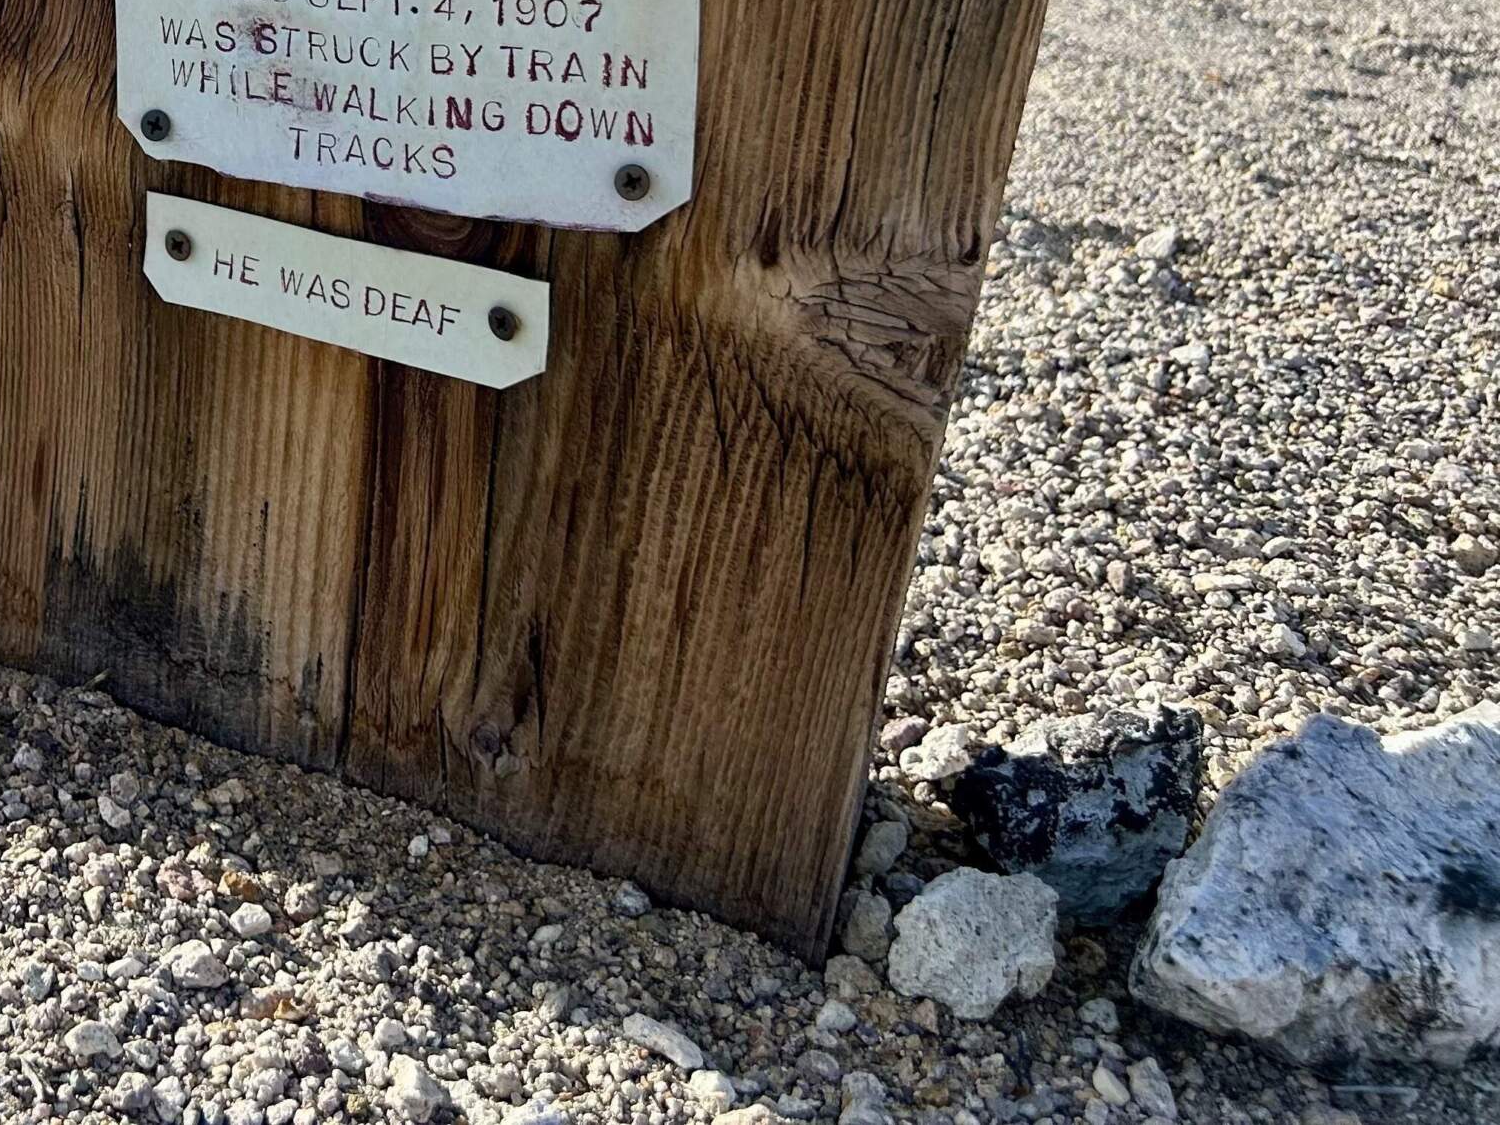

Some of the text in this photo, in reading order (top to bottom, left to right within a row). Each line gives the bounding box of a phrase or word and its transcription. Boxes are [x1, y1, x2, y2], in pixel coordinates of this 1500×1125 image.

[160, 15, 649, 90] WAS STRUCK BY TRAIN
[171, 58, 655, 147] WHILE WALKING DOWN
[288, 125, 457, 180] TRACKS
[212, 248, 461, 336] HE WAS DEAF
